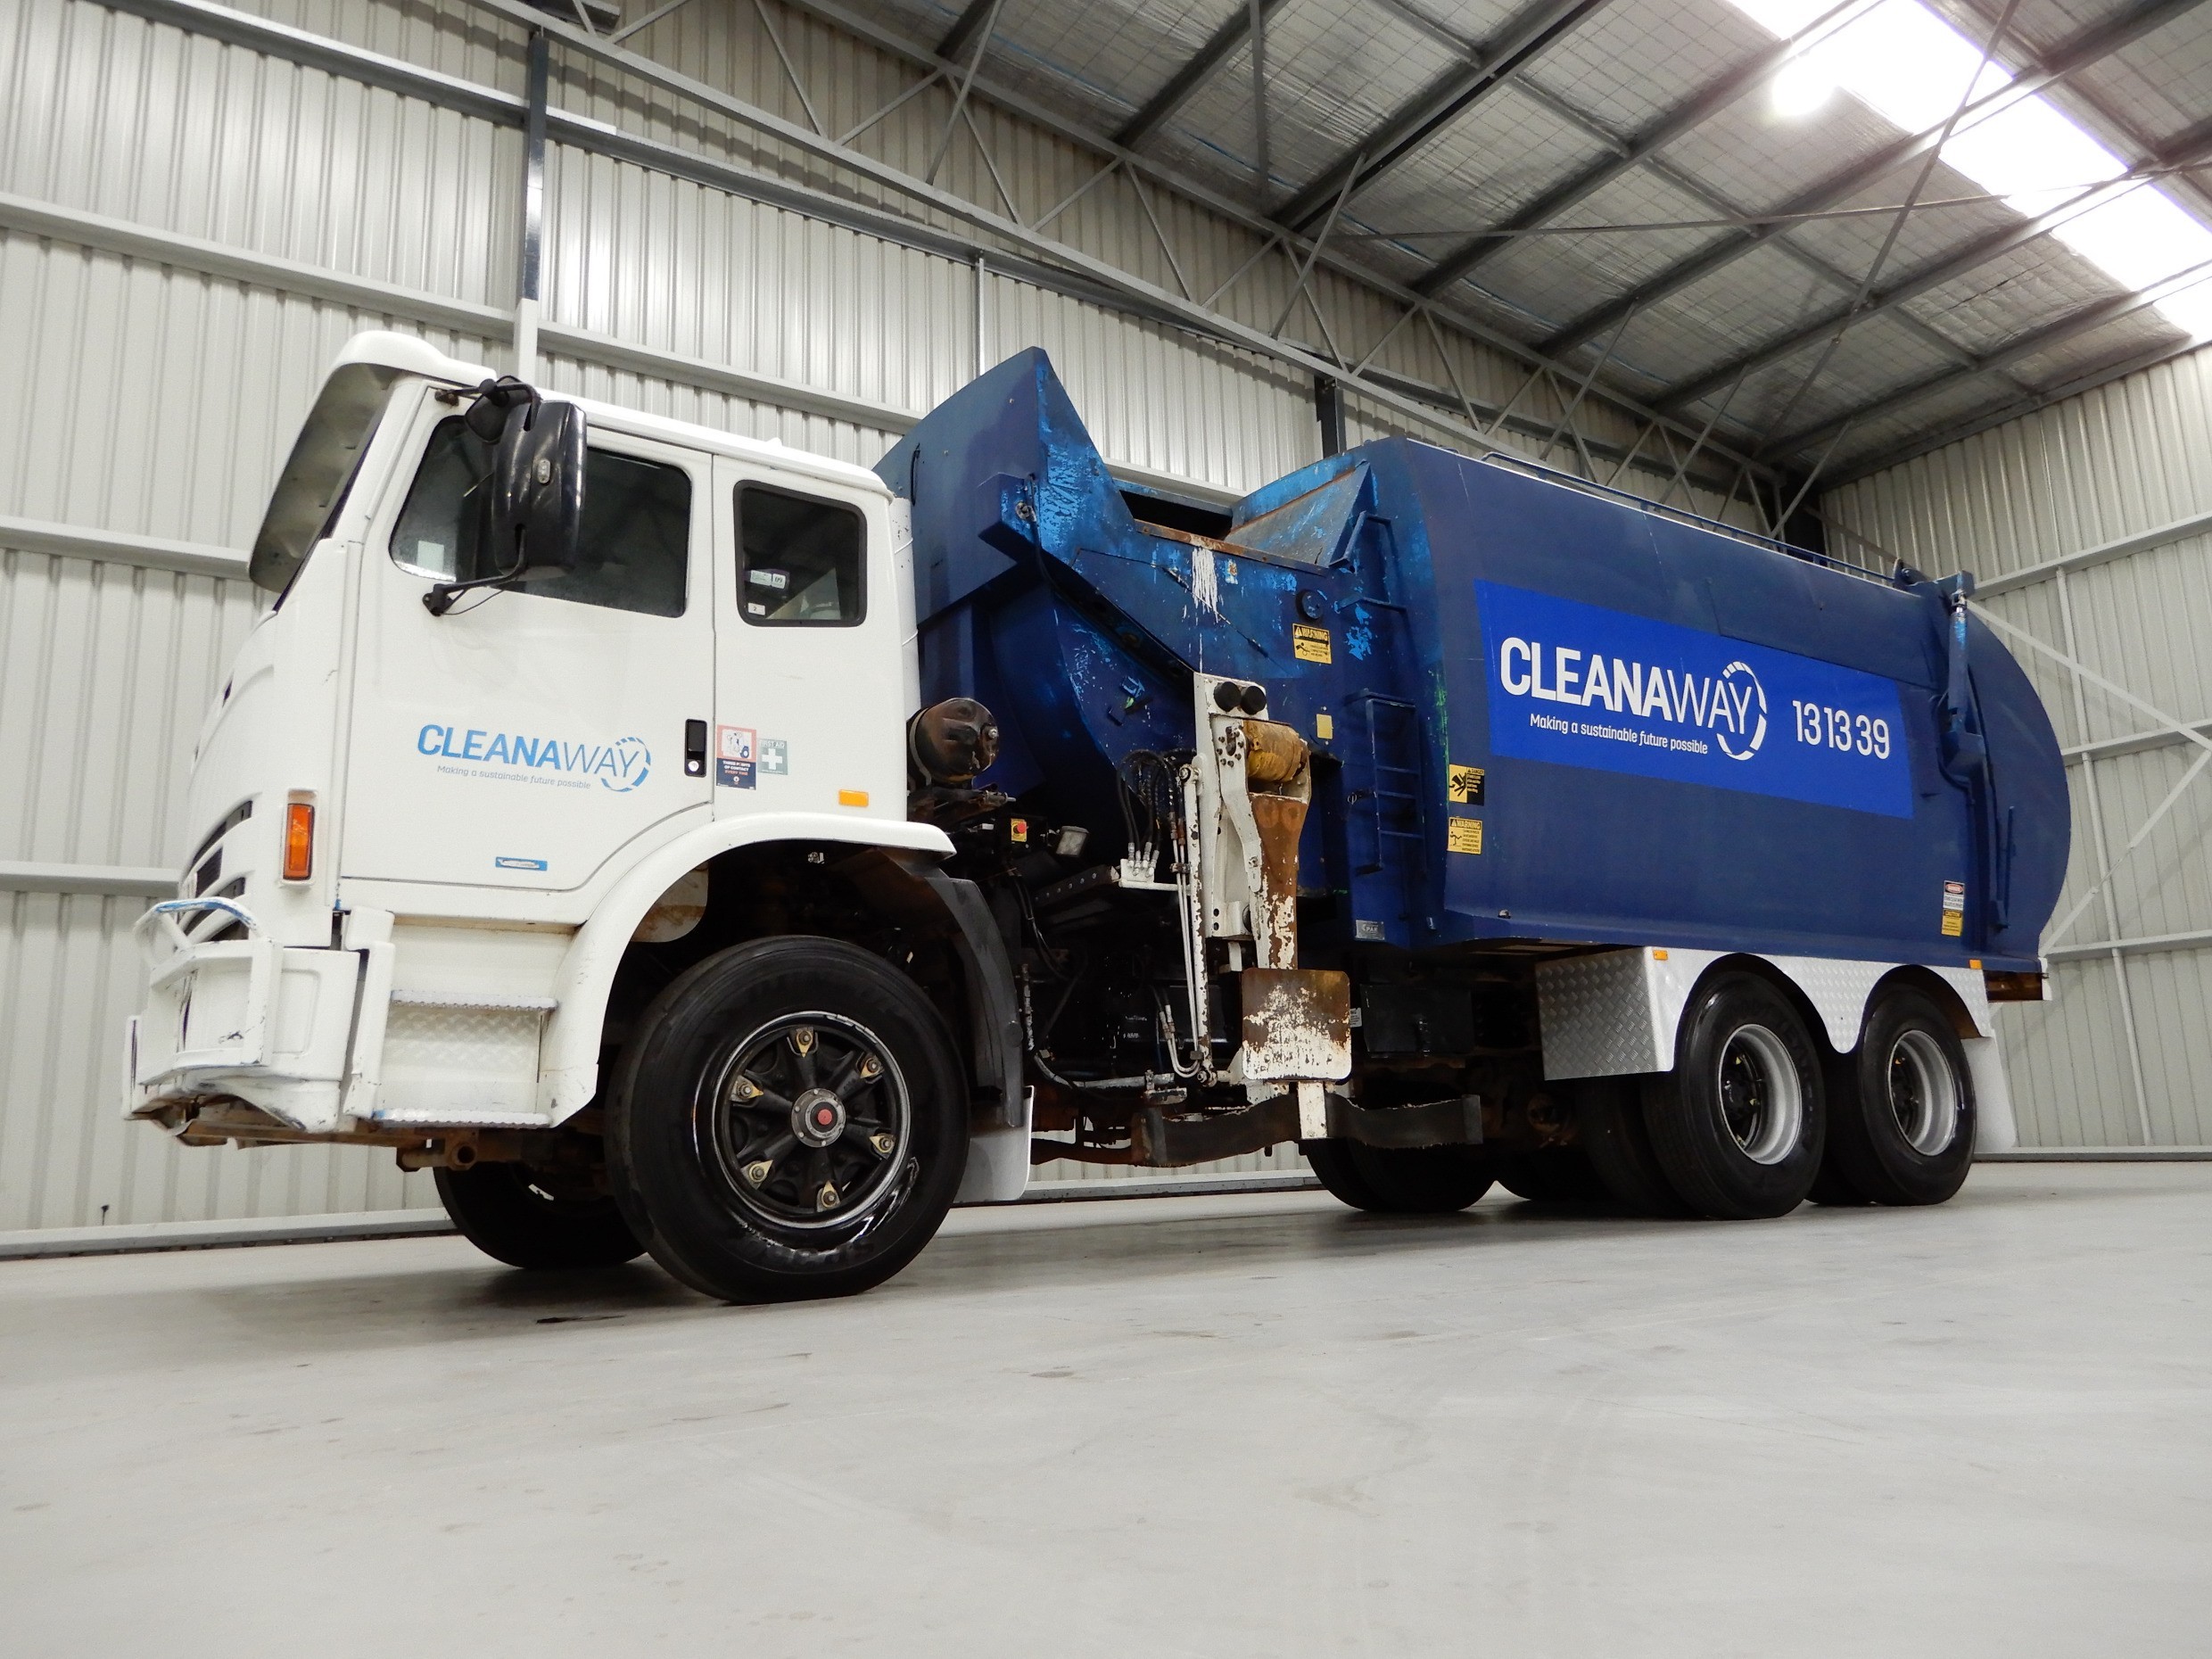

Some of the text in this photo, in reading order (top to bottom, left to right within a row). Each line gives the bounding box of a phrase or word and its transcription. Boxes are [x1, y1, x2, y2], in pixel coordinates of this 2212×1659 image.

[1301, 627, 1328, 641] WARNING
[1500, 637, 1752, 734] CLEANAWAY
[417, 723, 640, 779] CLEANAWAY
[1530, 714, 1708, 755] Making a sustainable future possible
[437, 764, 469, 777] Making
[479, 771, 528, 783] sustainable
[530, 774, 555, 785] future
[557, 779, 591, 789] possible
[1457, 819, 1481, 830] WARNING
